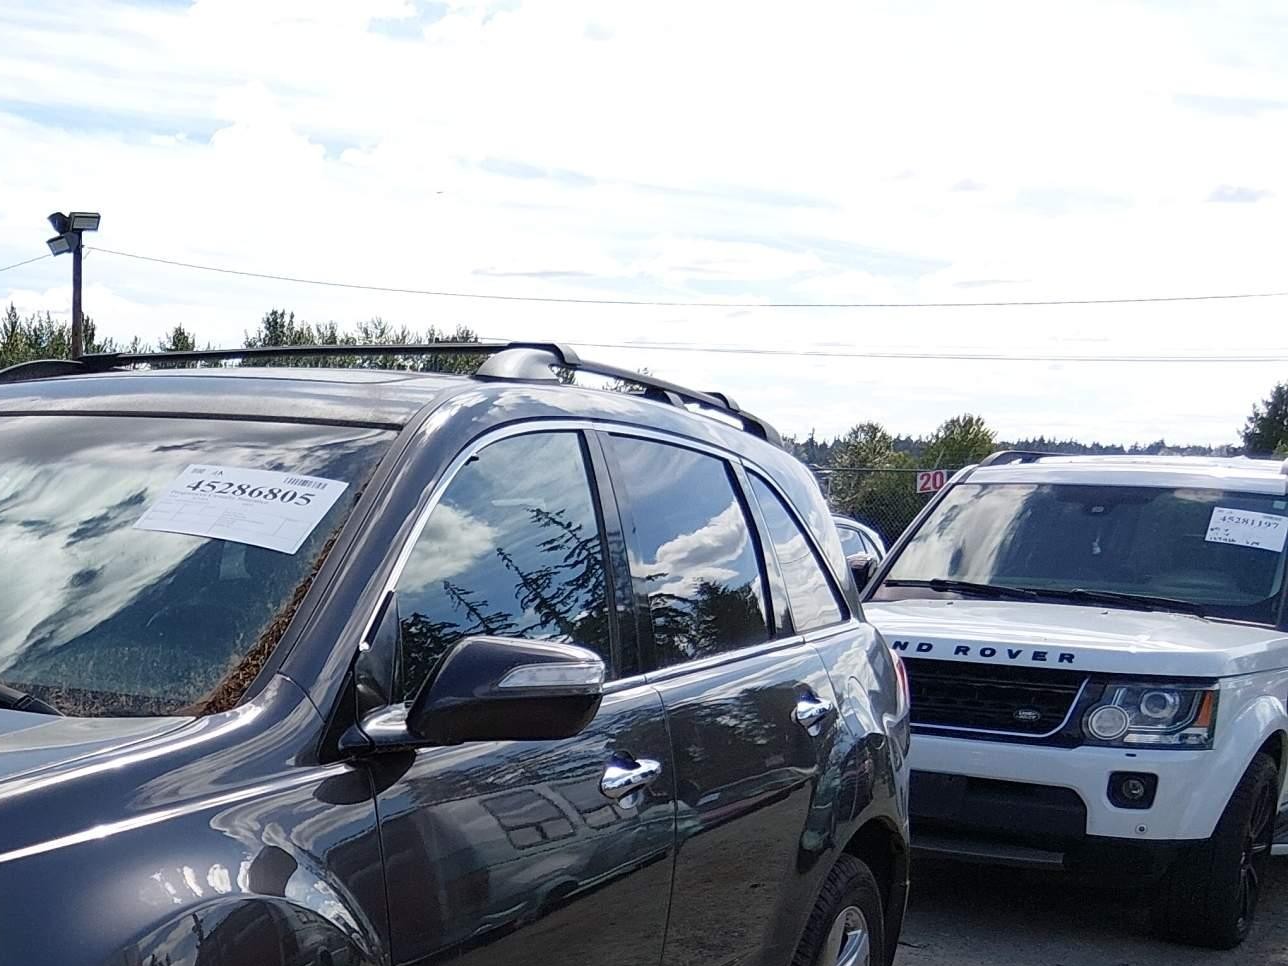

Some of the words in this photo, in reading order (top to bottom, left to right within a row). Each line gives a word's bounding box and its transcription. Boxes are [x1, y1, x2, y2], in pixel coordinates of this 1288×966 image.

[919, 471, 945, 492] 20
[186, 479, 316, 507] 45286805
[1219, 515, 1280, 529] 45281197
[892, 640, 934, 653] ND
[954, 645, 1076, 664] ROVER
